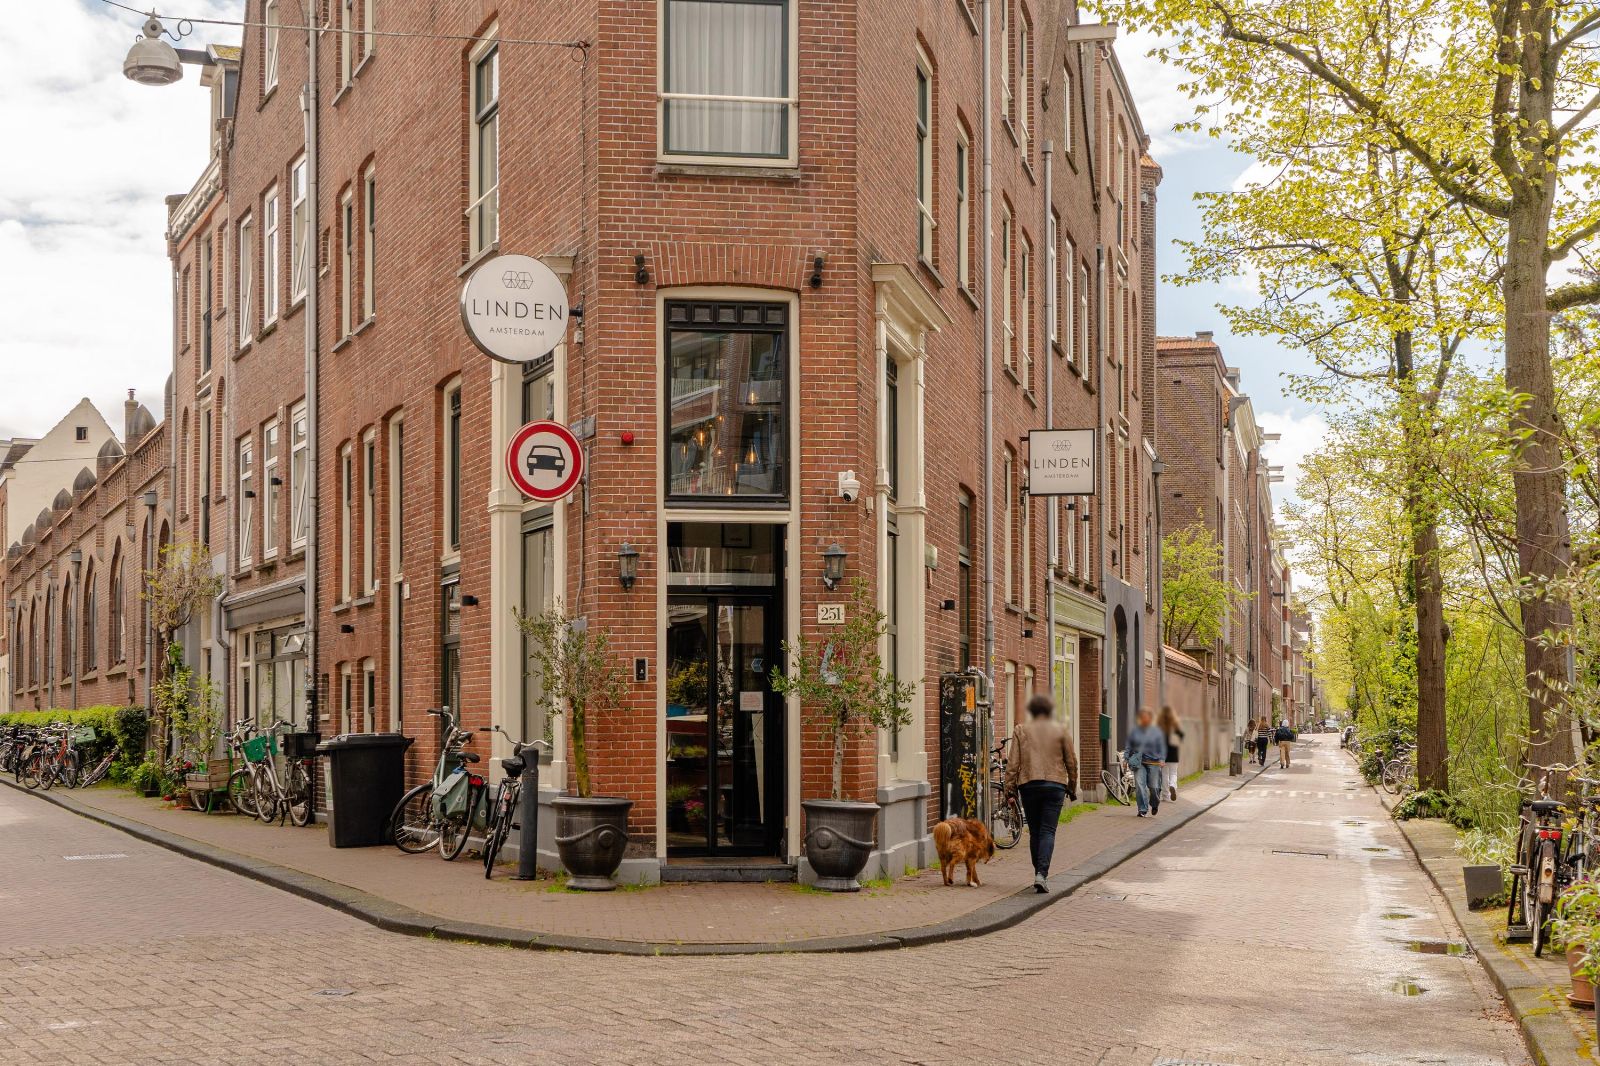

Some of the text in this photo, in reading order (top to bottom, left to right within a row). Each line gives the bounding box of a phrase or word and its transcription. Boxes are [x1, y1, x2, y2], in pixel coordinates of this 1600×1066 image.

[473, 298, 562, 320] LINDEN
[489, 327, 545, 336] AMSTERDAM
[1034, 457, 1090, 469] LINDEN
[820, 606, 842, 620] 251
